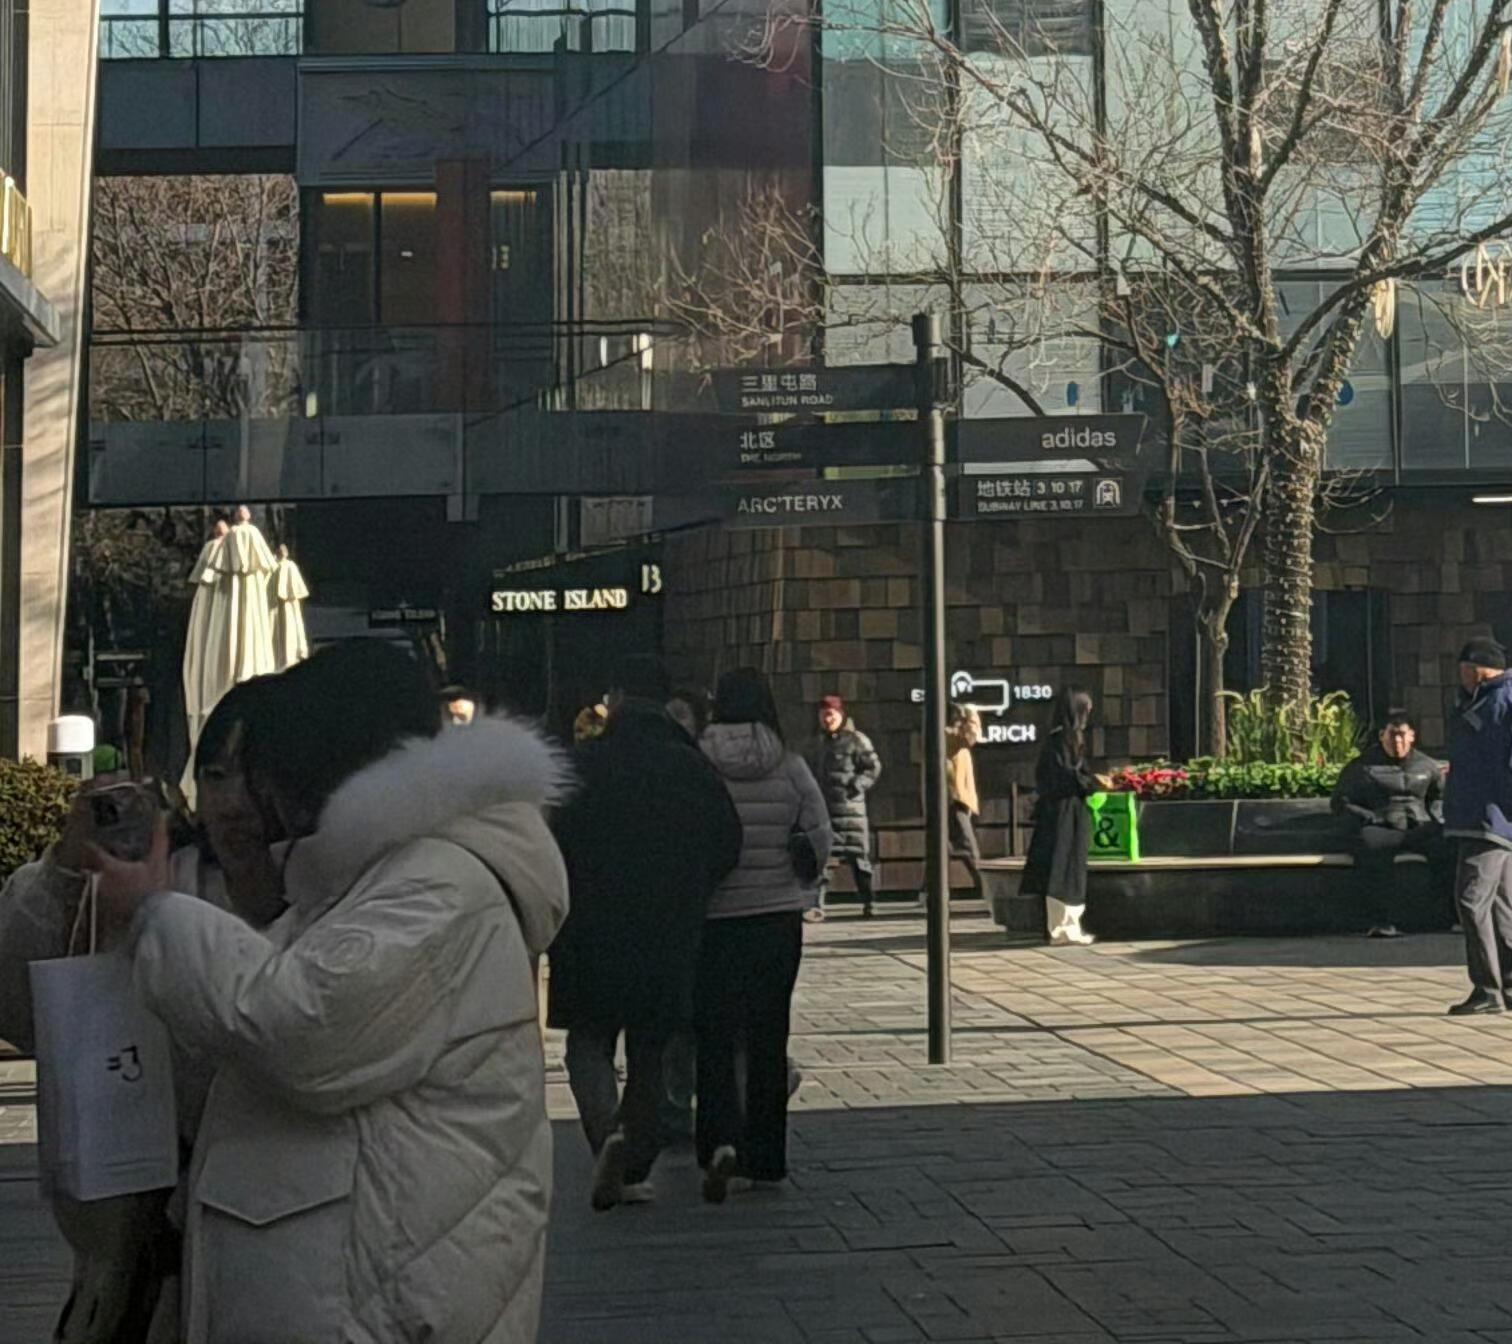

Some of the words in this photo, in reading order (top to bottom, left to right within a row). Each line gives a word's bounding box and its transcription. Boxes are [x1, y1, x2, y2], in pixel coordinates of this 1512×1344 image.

[741, 395, 798, 407] SANLITUN
[801, 394, 833, 406] ROAD
[740, 431, 775, 449] 北区
[1041, 426, 1117, 448] adidas
[977, 479, 1031, 497] 地铁站
[1036, 481, 1046, 494] 3
[1051, 481, 1065, 494] 10
[1068, 480, 1084, 494] 17
[737, 495, 843, 513] ARC'TERYX
[491, 589, 557, 611] STONE
[563, 588, 628, 610] ISLAND
[1014, 685, 1053, 700] 1830
